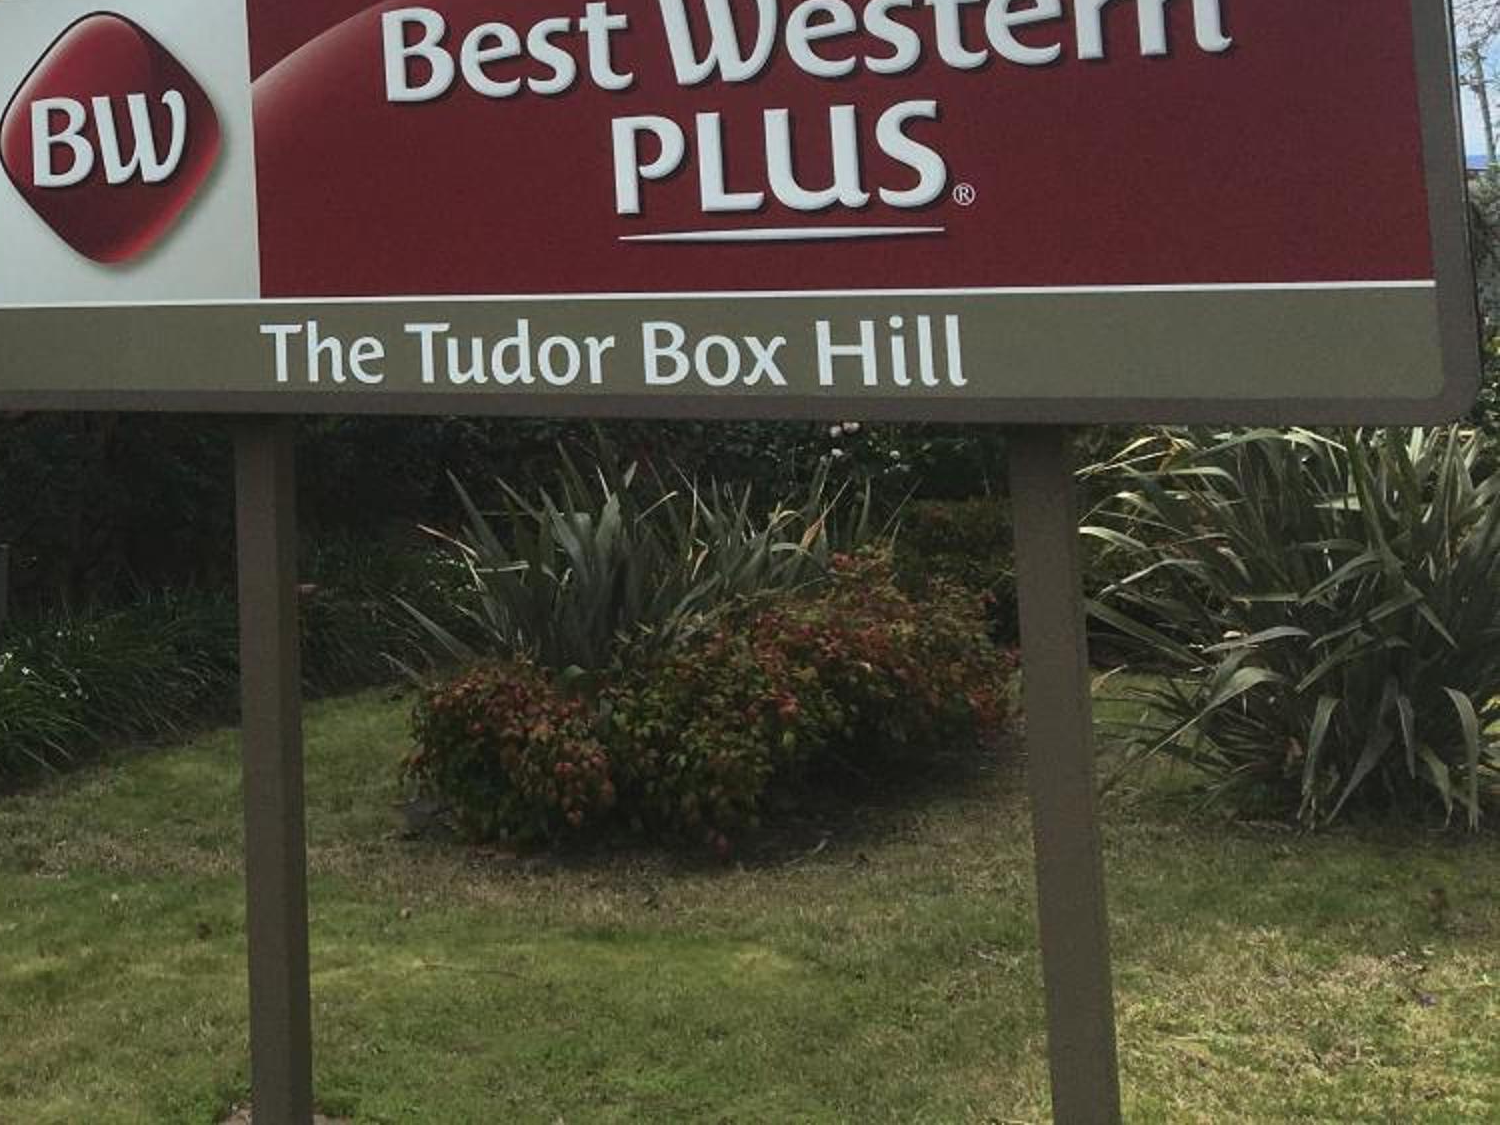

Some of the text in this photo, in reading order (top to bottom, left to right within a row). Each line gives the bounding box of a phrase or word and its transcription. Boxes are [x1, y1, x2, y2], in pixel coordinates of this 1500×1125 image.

[380, 1, 633, 103] Best
[31, 89, 187, 188] BW
[612, 100, 947, 215] PLUS
[260, 315, 968, 386] The Tudor Box Hill
